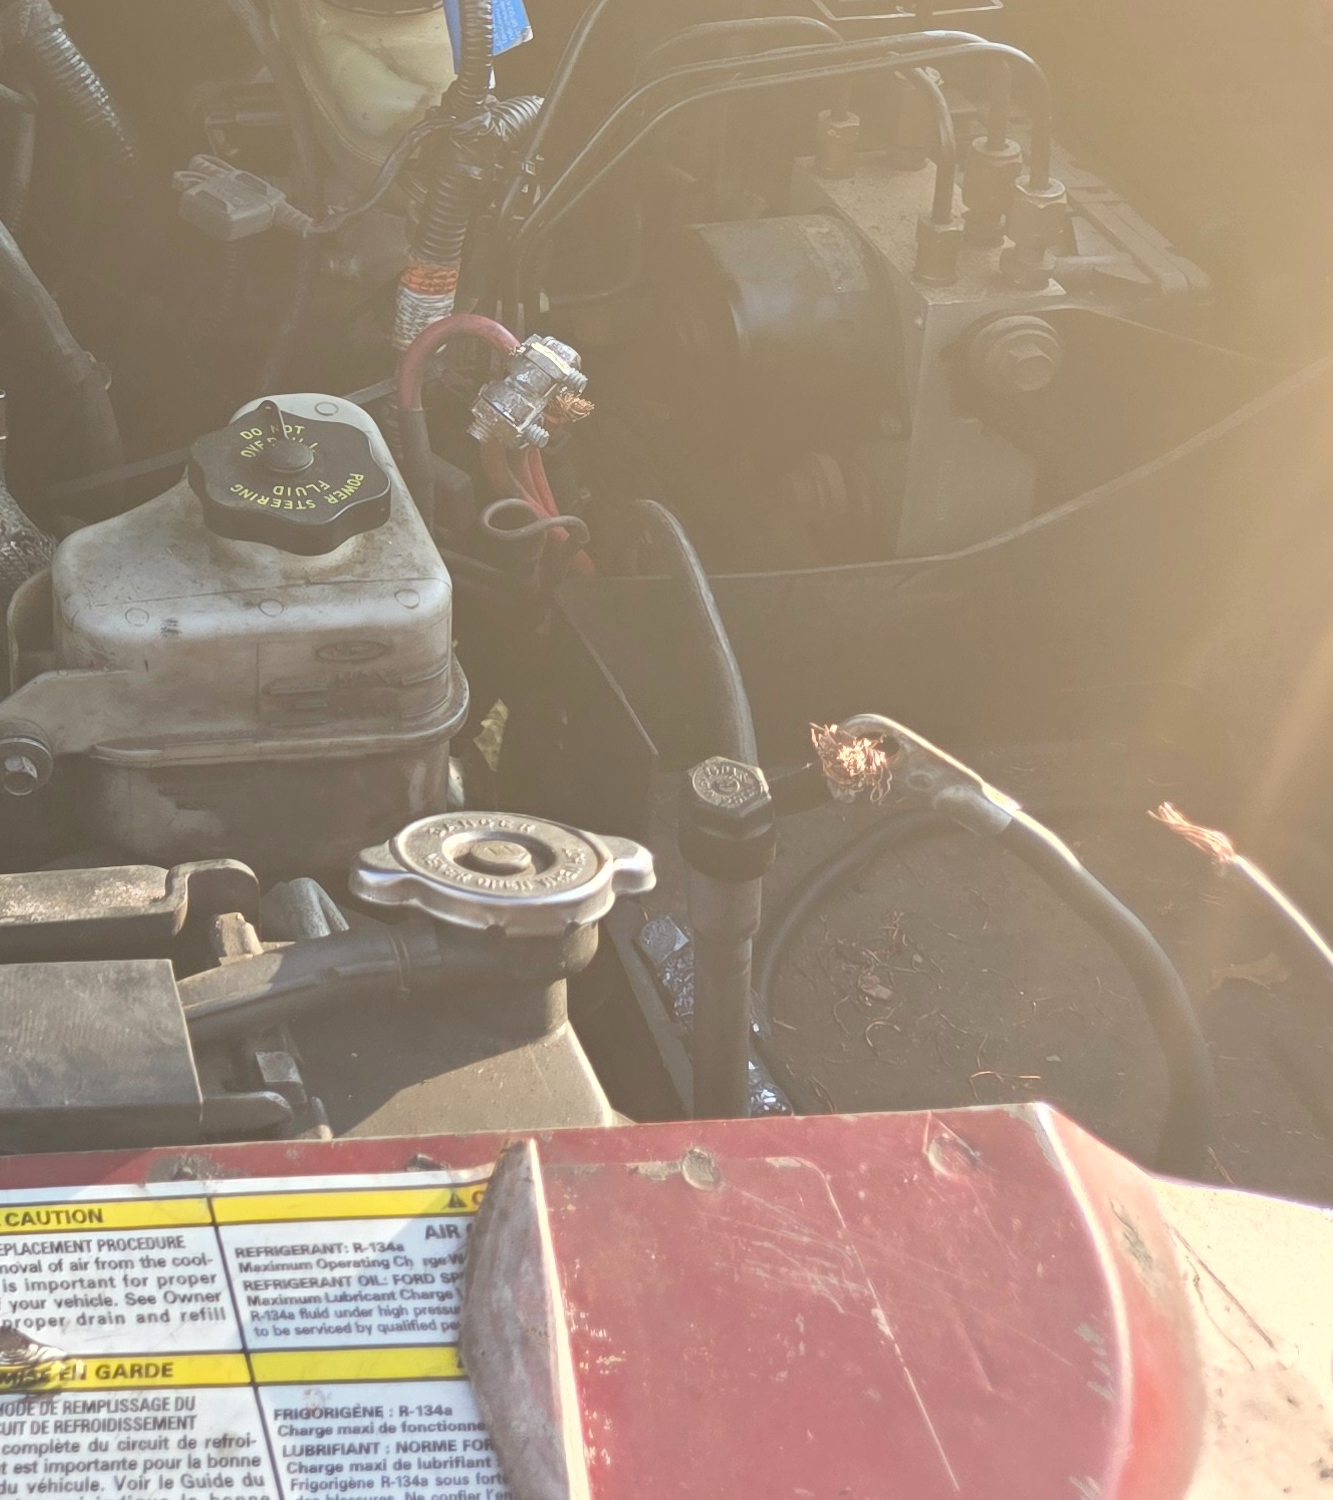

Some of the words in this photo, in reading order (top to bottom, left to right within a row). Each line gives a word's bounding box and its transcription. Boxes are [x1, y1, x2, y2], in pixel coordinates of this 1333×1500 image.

[240, 427, 263, 440] DO
[230, 484, 316, 510] STEERING
[273, 479, 330, 497] FLUID
[324, 473, 364, 504] POWER
[4, 1208, 104, 1228] CAUTION
[425, 1224, 461, 1240] AIR
[96, 1235, 186, 1254] PROCEDURE
[235, 1242, 349, 1259] REFRIGERANT:
[352, 1241, 405, 1255] R-134a
[48, 1258, 64, 1273] of
[69, 1257, 89, 1272] air
[94, 1255, 135, 1271] from
[139, 1254, 167, 1269] the
[171, 1252, 214, 1268] cool-
[95, 1361, 174, 1381] GARDE
[273, 1403, 383, 1421] FRIGORIGÈNE
[398, 1405, 453, 1418] R-134a
